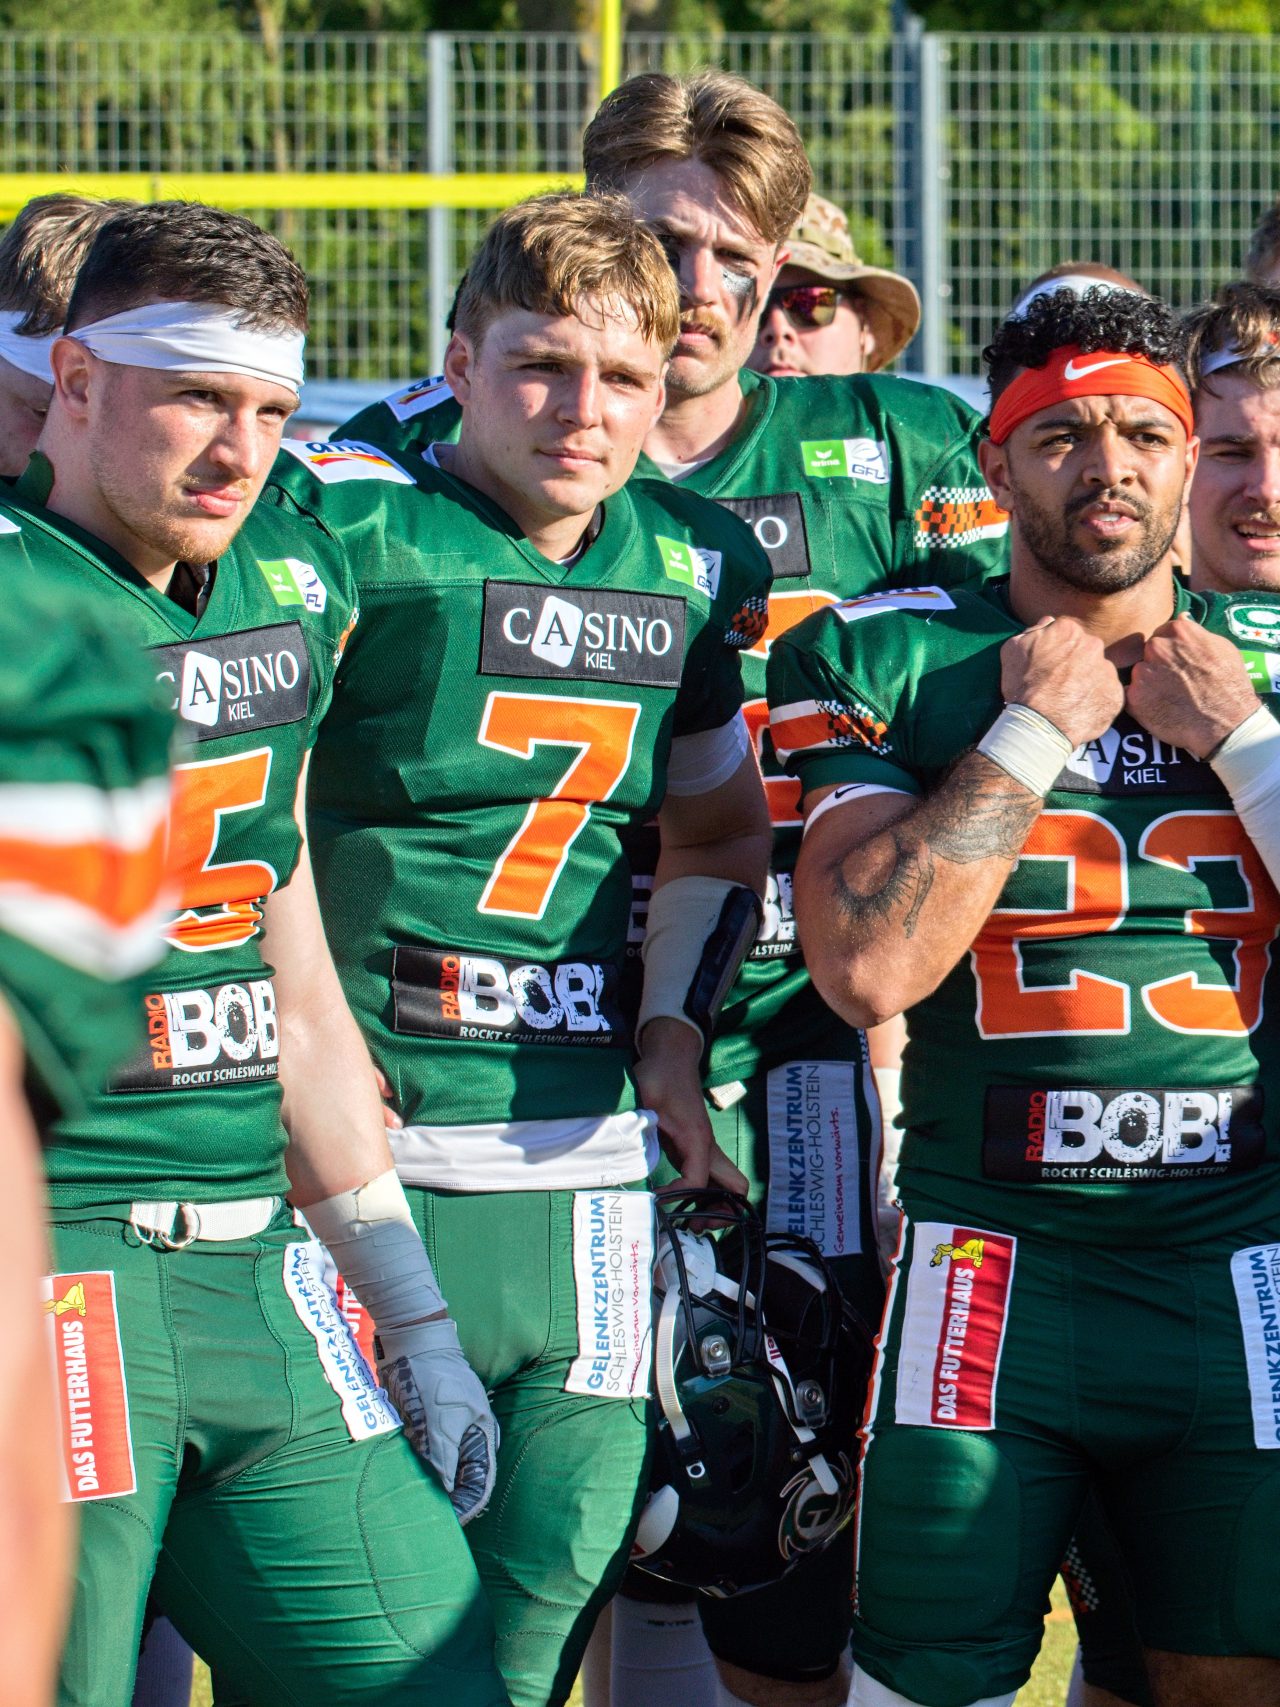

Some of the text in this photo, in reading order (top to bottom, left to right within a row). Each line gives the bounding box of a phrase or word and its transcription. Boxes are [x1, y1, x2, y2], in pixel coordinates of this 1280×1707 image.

[852, 463, 886, 480] GFL
[503, 607, 673, 656] CASINO
[585, 652, 616, 671] KIEL
[228, 700, 255, 722] KIEL
[477, 691, 642, 921] 7
[1123, 768, 1167, 785] KIEL
[162, 979, 280, 1069] BOB
[440, 956, 462, 1021] RADIO
[145, 993, 174, 1071] RADIO
[459, 1026, 613, 1045] ROCKT SCHLESWIG-HOLSTEIN
[172, 1064, 280, 1086] ROCKT SCHLESWIG-HOL
[786, 1065, 806, 1236] ELENKZENTRUM
[1024, 1090, 1048, 1162] RADIO
[1042, 1090, 1233, 1164] BOB!
[830, 1106, 845, 1255] Gemeinsam vorwärts.
[1041, 1165, 1229, 1179] ROCKT SCHLESWIG-HOLSTEIN
[586, 1195, 612, 1390] GELENKZENTRUM
[606, 1195, 628, 1392] SCHLESWIG-HOLSTEIN
[627, 1240, 640, 1393] Gemeinsam vorwärts.
[936, 1267, 976, 1421] DAS FUTTERHAUS
[62, 1320, 100, 1492] DAS FUTTERHAUS
